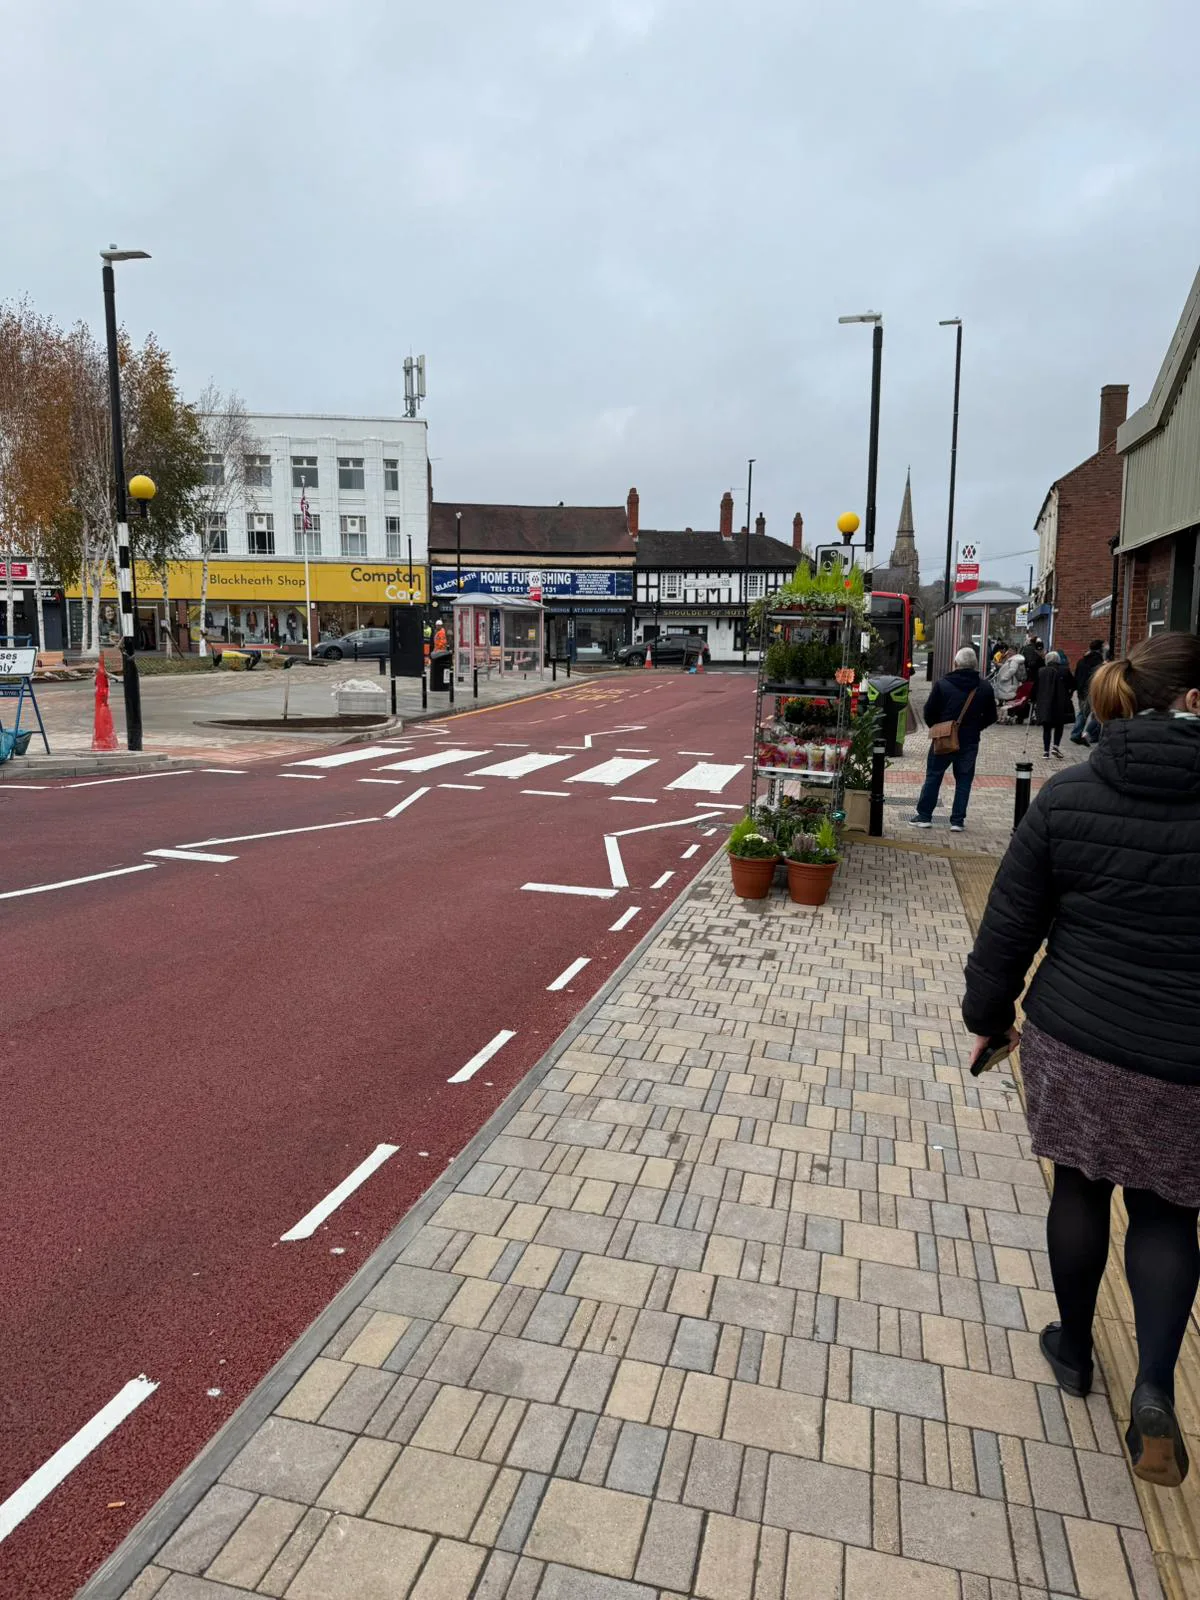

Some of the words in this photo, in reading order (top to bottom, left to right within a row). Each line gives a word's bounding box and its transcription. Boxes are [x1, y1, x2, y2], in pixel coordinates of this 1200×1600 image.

[209, 574, 273, 586] Blackheath
[277, 575, 306, 589] Shop
[351, 567, 421, 591] Compton
[435, 572, 477, 592] BLACKEATH
[480, 572, 509, 584] HOME
[511, 572, 571, 585] FURSHING
